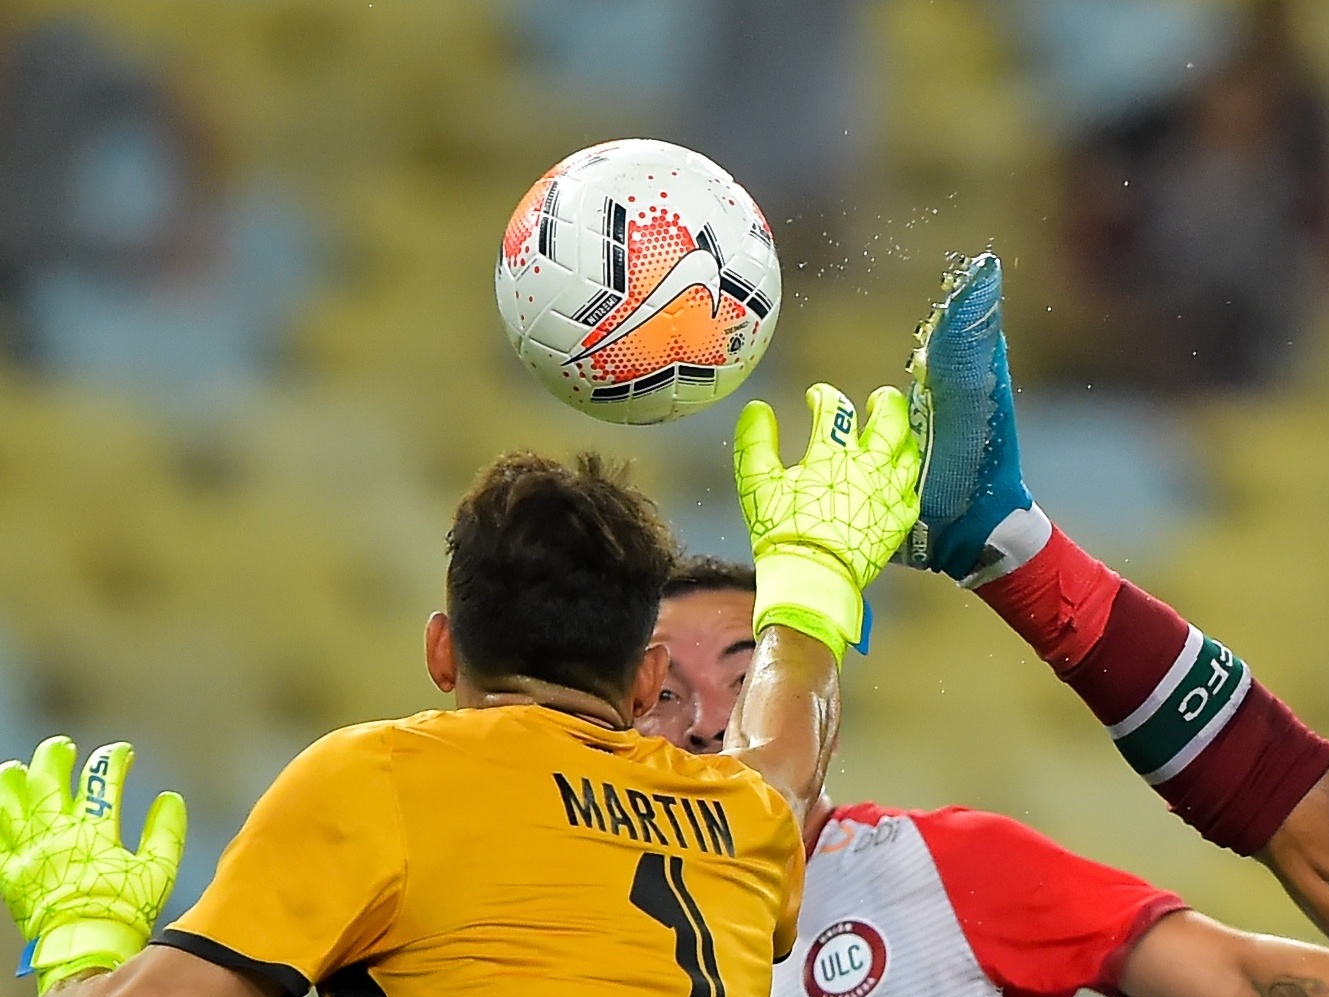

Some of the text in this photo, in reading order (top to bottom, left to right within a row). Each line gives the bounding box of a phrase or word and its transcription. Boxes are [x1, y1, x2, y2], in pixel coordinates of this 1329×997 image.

[1177, 638, 1234, 722] FFC
[552, 771, 736, 858] MARTIN
[820, 944, 864, 982] ULC
